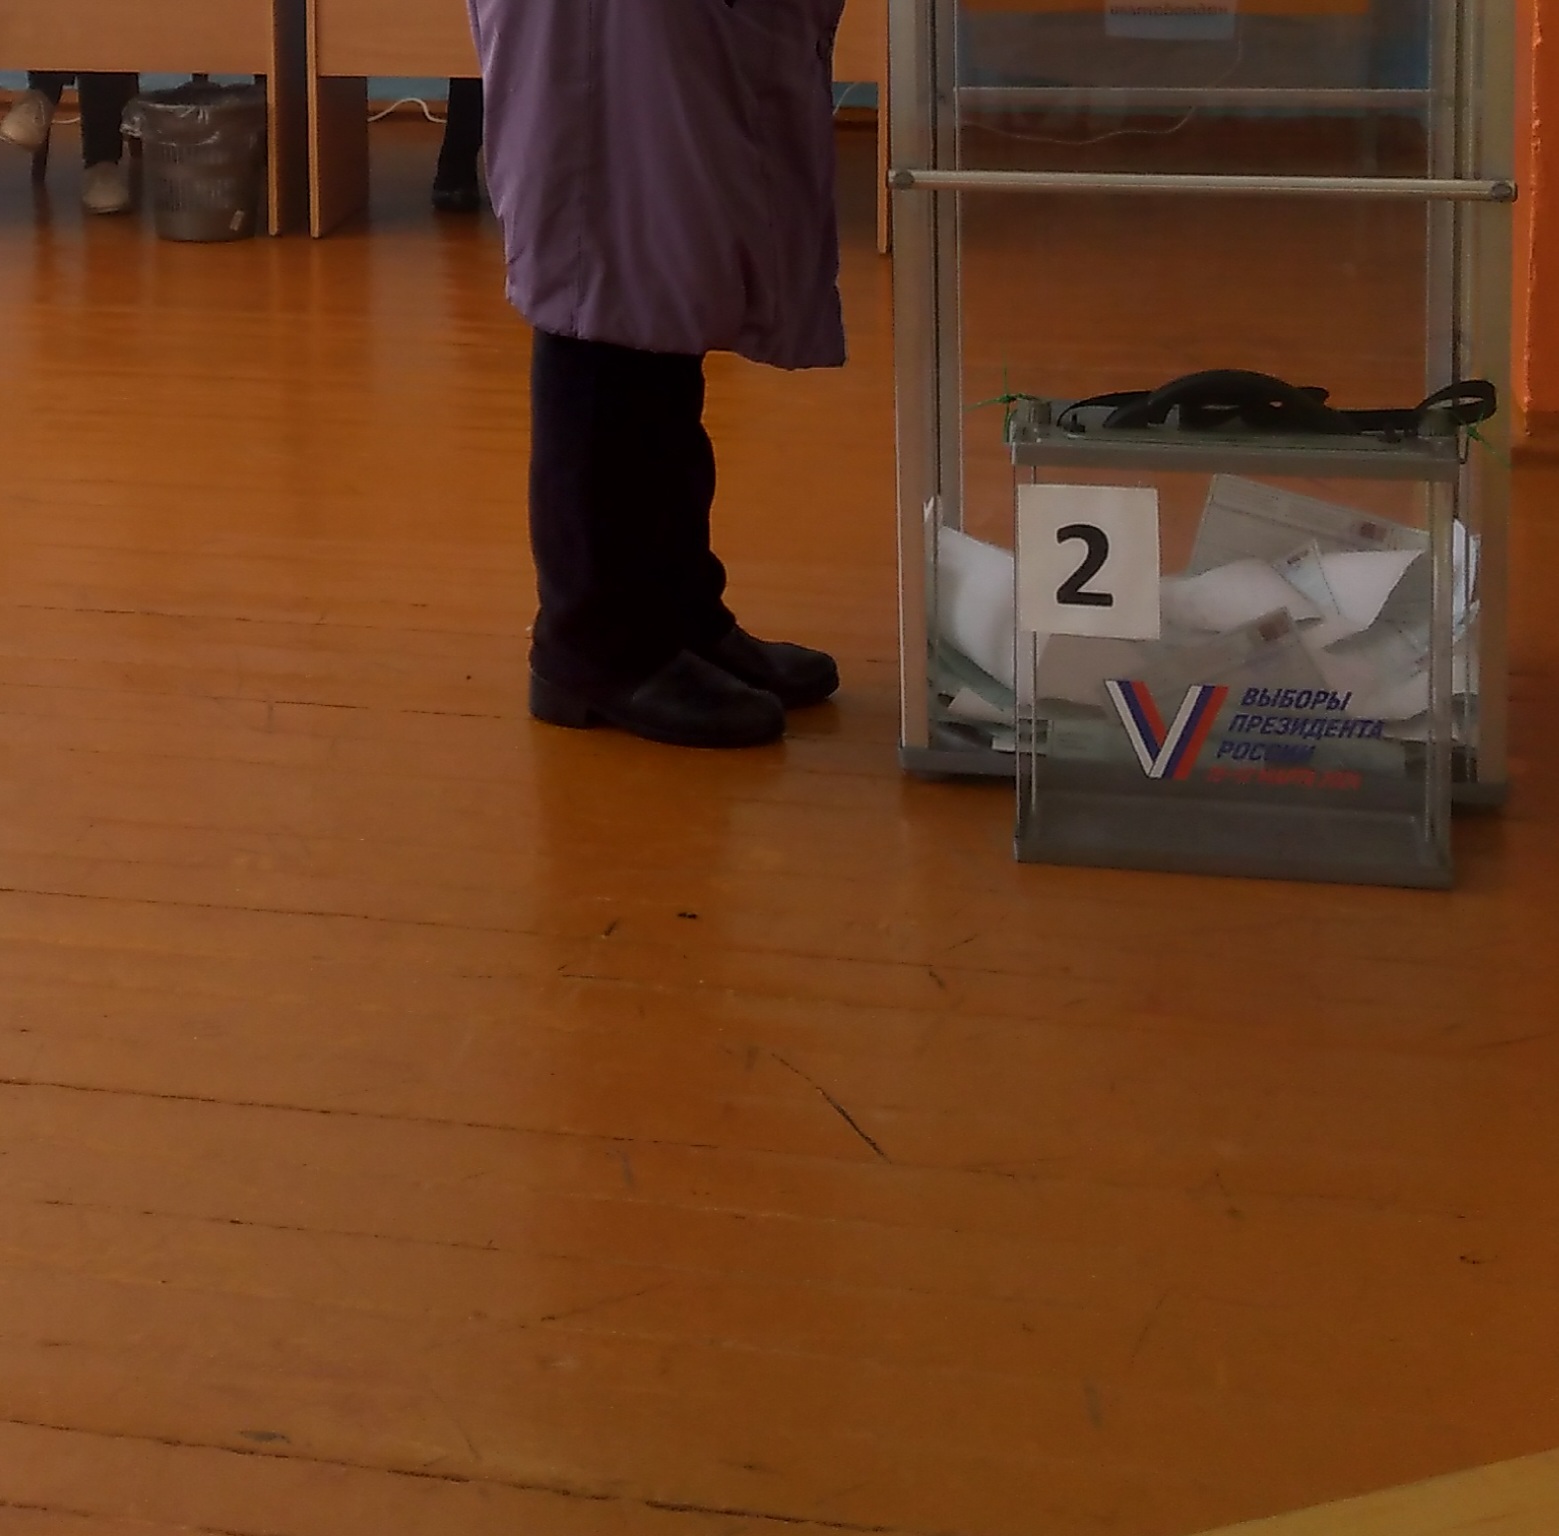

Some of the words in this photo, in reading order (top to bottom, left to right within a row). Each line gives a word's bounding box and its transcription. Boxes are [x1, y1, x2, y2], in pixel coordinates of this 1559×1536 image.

[1056, 523, 1114, 608] 2
[1241, 687, 1353, 712] ВЫБОРЫ
[1228, 714, 1386, 740] ПРЕЗИДЕНТА
